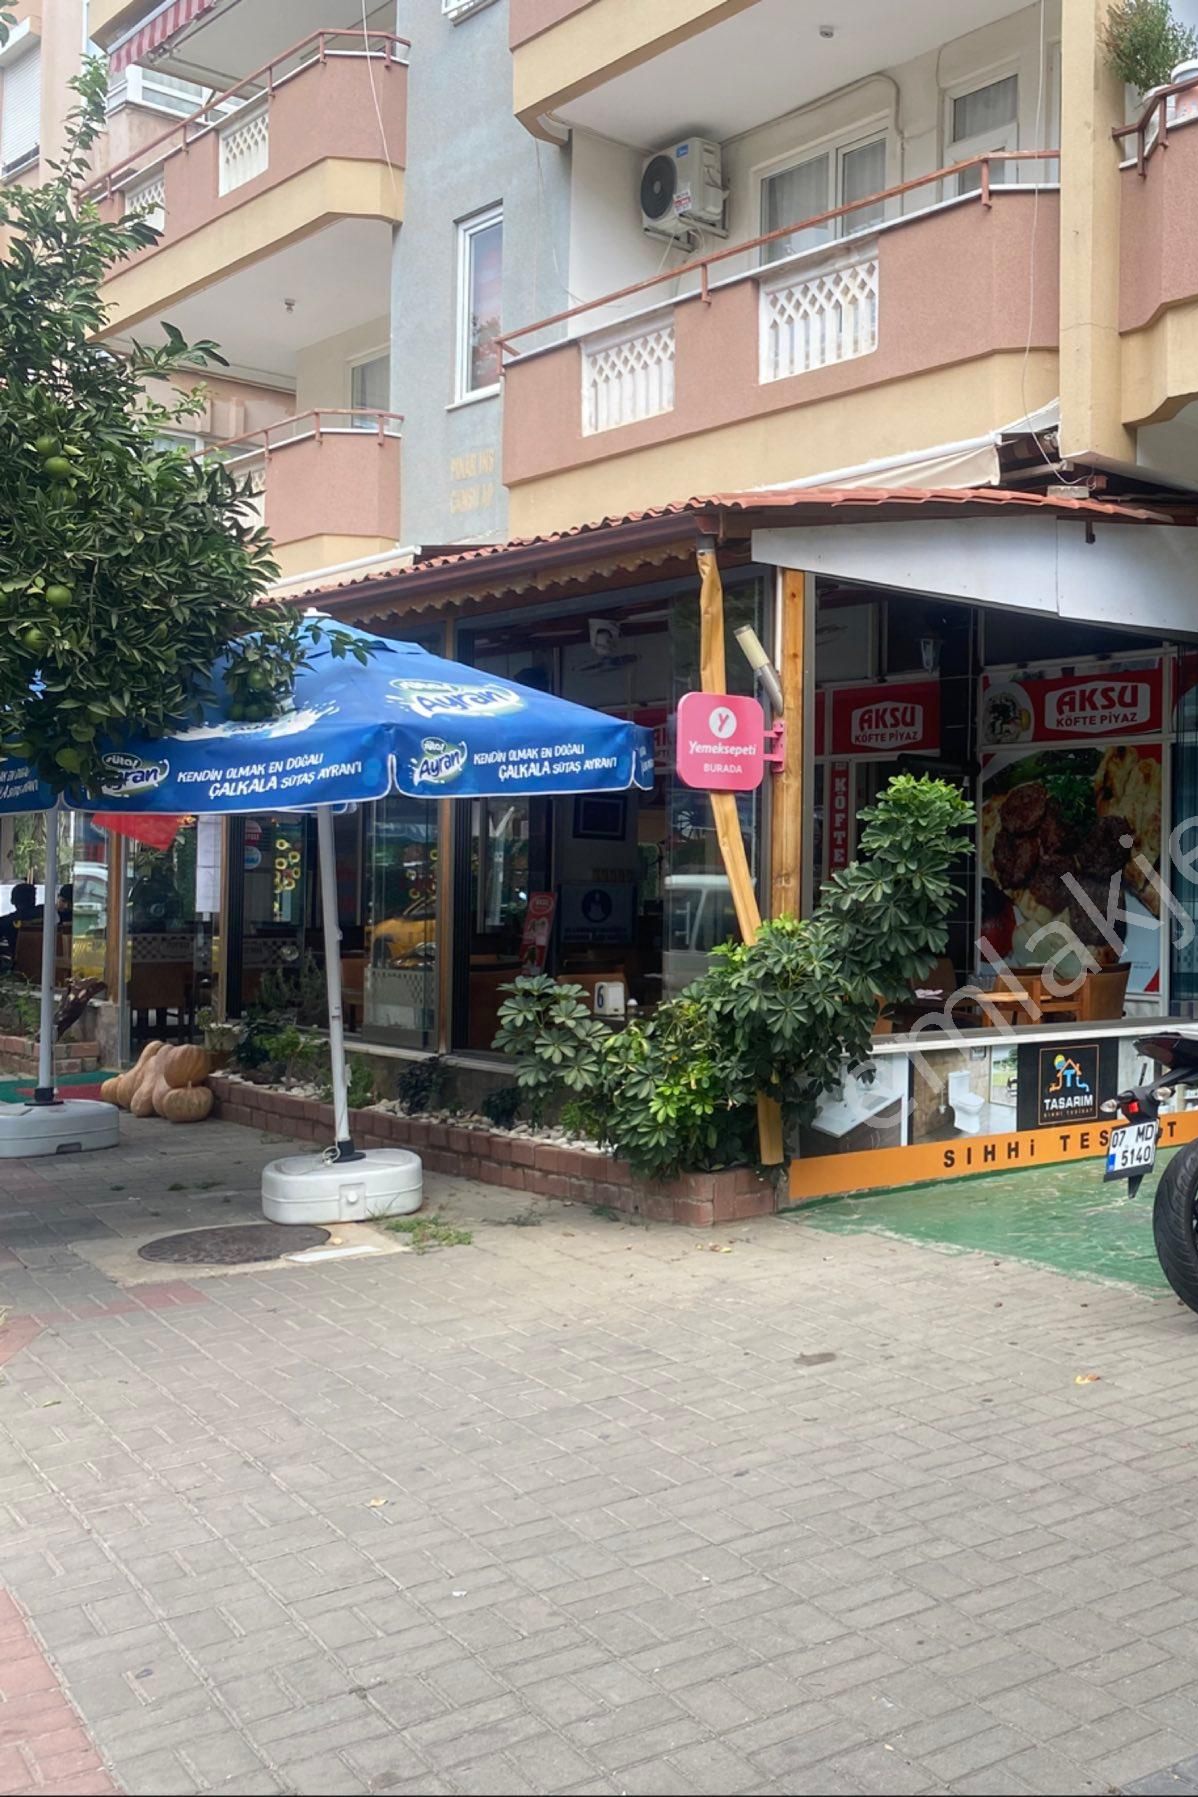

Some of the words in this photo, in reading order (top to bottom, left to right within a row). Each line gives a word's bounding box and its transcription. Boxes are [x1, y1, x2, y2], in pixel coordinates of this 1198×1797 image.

[416, 690, 502, 710] Ayran
[1056, 684, 1139, 717] AKSU
[858, 705, 916, 731] AKSU
[1056, 713, 1097, 727] KÖFTE
[1100, 710, 1138, 724] PİYAZ
[855, 731, 887, 744] KÖFTE
[888, 729, 919, 741] PİYAZ
[508, 748, 539, 761] OLMAK
[540, 746, 552, 758] EN
[688, 740, 757, 757] Yemeksepeti
[226, 763, 266, 779] OLMAK
[268, 761, 285, 774] EN
[286, 753, 324, 770] DOĞALI
[420, 750, 461, 777] Ayran
[498, 760, 551, 782] ÇALKALA
[552, 760, 581, 775] SÜTAŞ
[703, 763, 743, 774] BURADA
[208, 776, 278, 800] ÇALKALA
[280, 772, 315, 789] SÜTAŞ
[833, 777, 847, 863] KÖFTE
[1044, 1094, 1094, 1111] TASARIM
[1111, 1129, 1127, 1148] 07
[1135, 1124, 1155, 1142] MD
[1120, 1148, 1151, 1167] 5140
